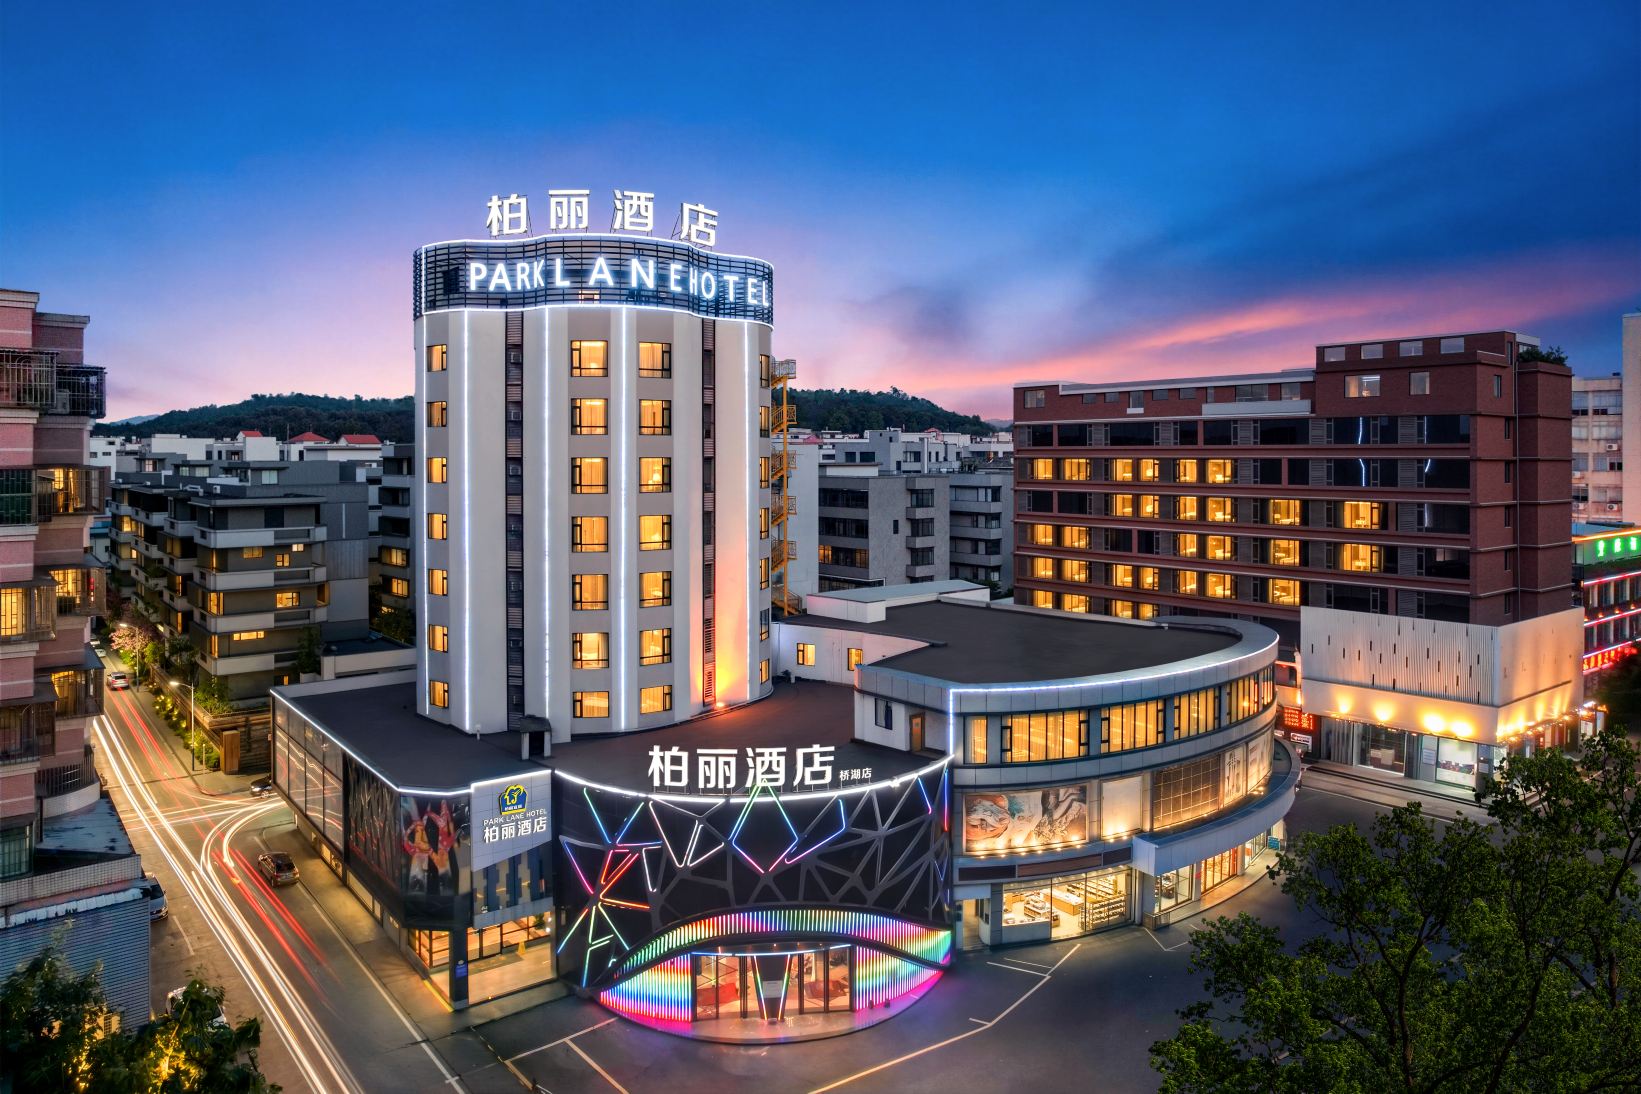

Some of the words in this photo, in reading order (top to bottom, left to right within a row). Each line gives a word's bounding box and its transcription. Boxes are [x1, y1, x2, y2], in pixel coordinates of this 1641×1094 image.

[486, 190, 718, 247] 柏丽酒店
[469, 260, 545, 291] PARK
[555, 257, 682, 291] LANE
[690, 267, 770, 307] HOTEL
[648, 744, 835, 788] 柏丽酒店
[839, 767, 872, 781] 桥湖店
[483, 817, 505, 826] PARK
[506, 813, 524, 822] LANE
[526, 808, 547, 817] HOTEL
[484, 817, 547, 843] 柏丽酒店
